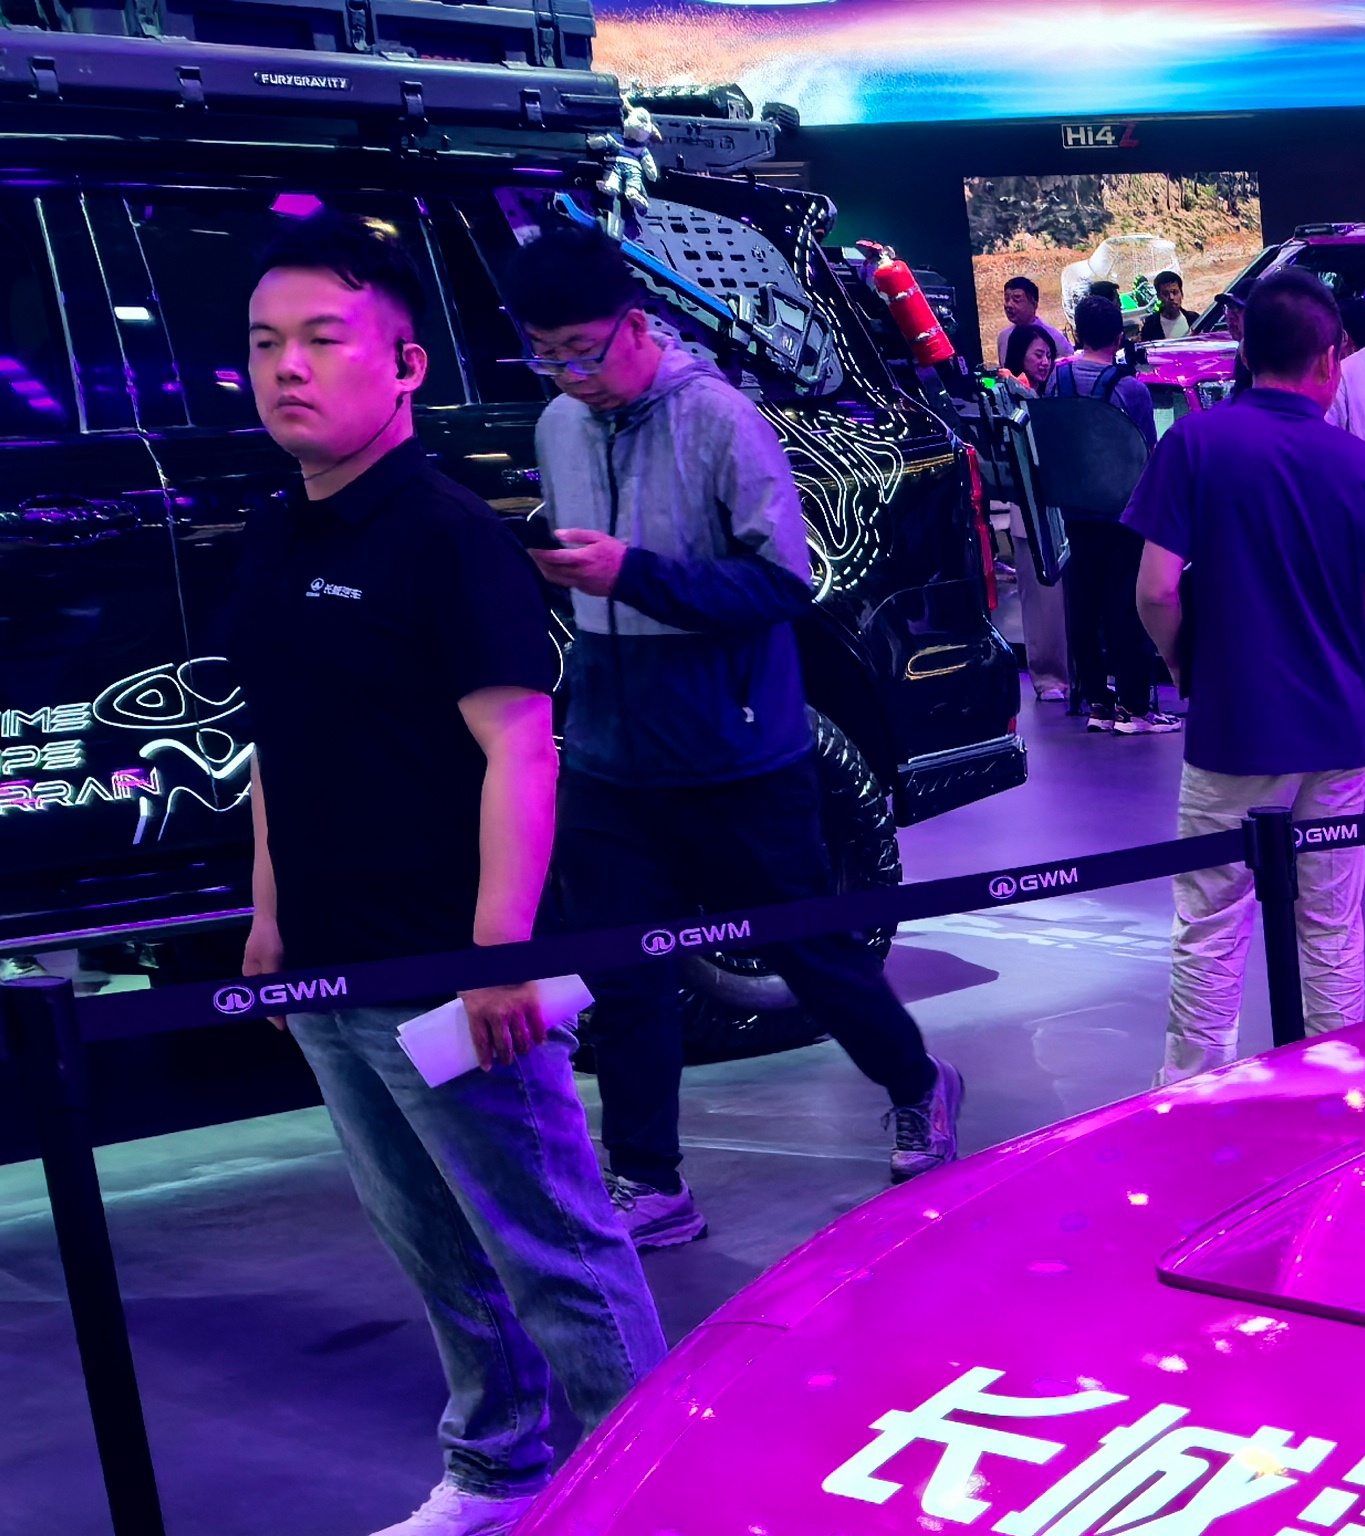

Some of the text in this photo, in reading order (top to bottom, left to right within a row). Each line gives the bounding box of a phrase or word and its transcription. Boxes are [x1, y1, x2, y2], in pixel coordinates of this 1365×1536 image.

[1305, 823, 1359, 845] GWM
[1019, 867, 1079, 893] GWM
[678, 920, 752, 948] GWM
[259, 976, 348, 1005] GWM
